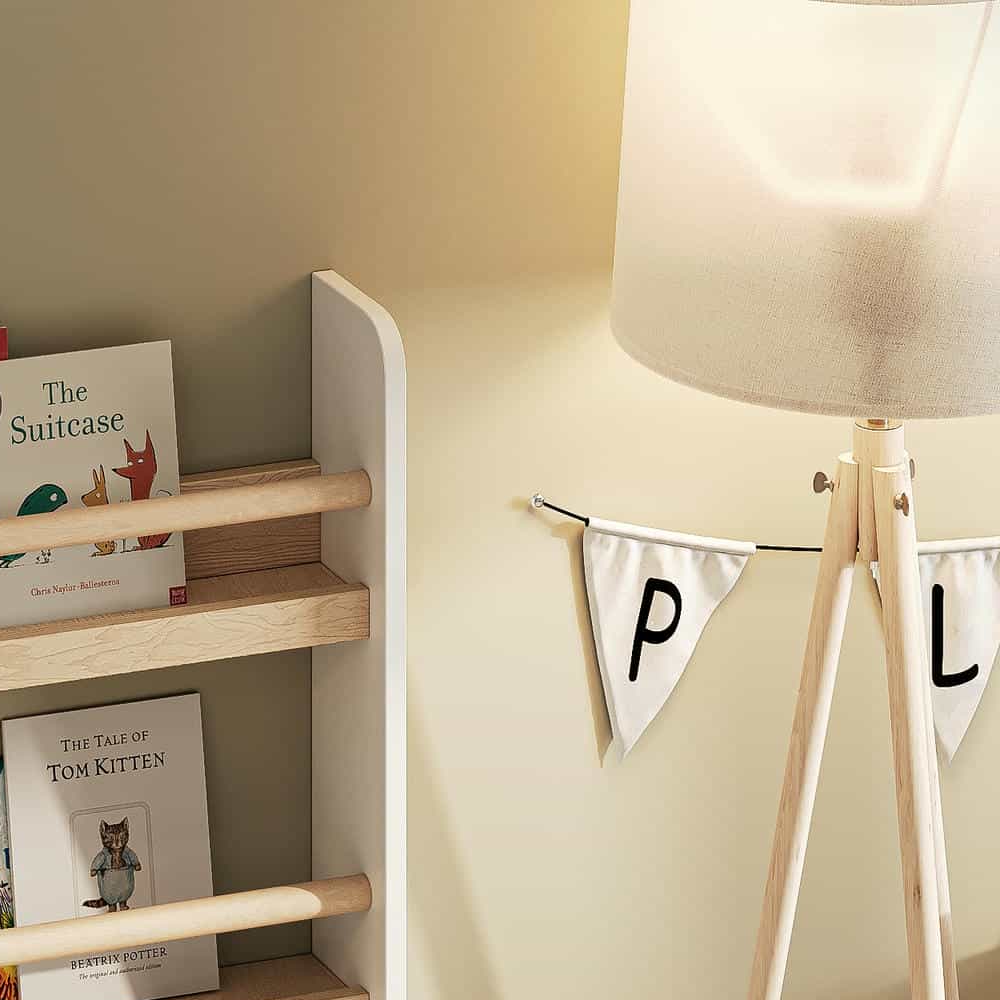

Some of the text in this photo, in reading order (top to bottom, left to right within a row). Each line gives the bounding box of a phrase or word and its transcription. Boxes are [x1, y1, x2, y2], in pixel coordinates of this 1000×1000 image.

[42, 380, 88, 406] The
[10, 412, 125, 445] Suitcase
[30, 583, 51, 597] Chris
[628, 576, 683, 683] P
[931, 583, 980, 688] L
[60, 730, 149, 753] THE TALE OF
[46, 751, 166, 782] TOM KITTEN
[71, 946, 168, 970] BEATRIX POTTER
